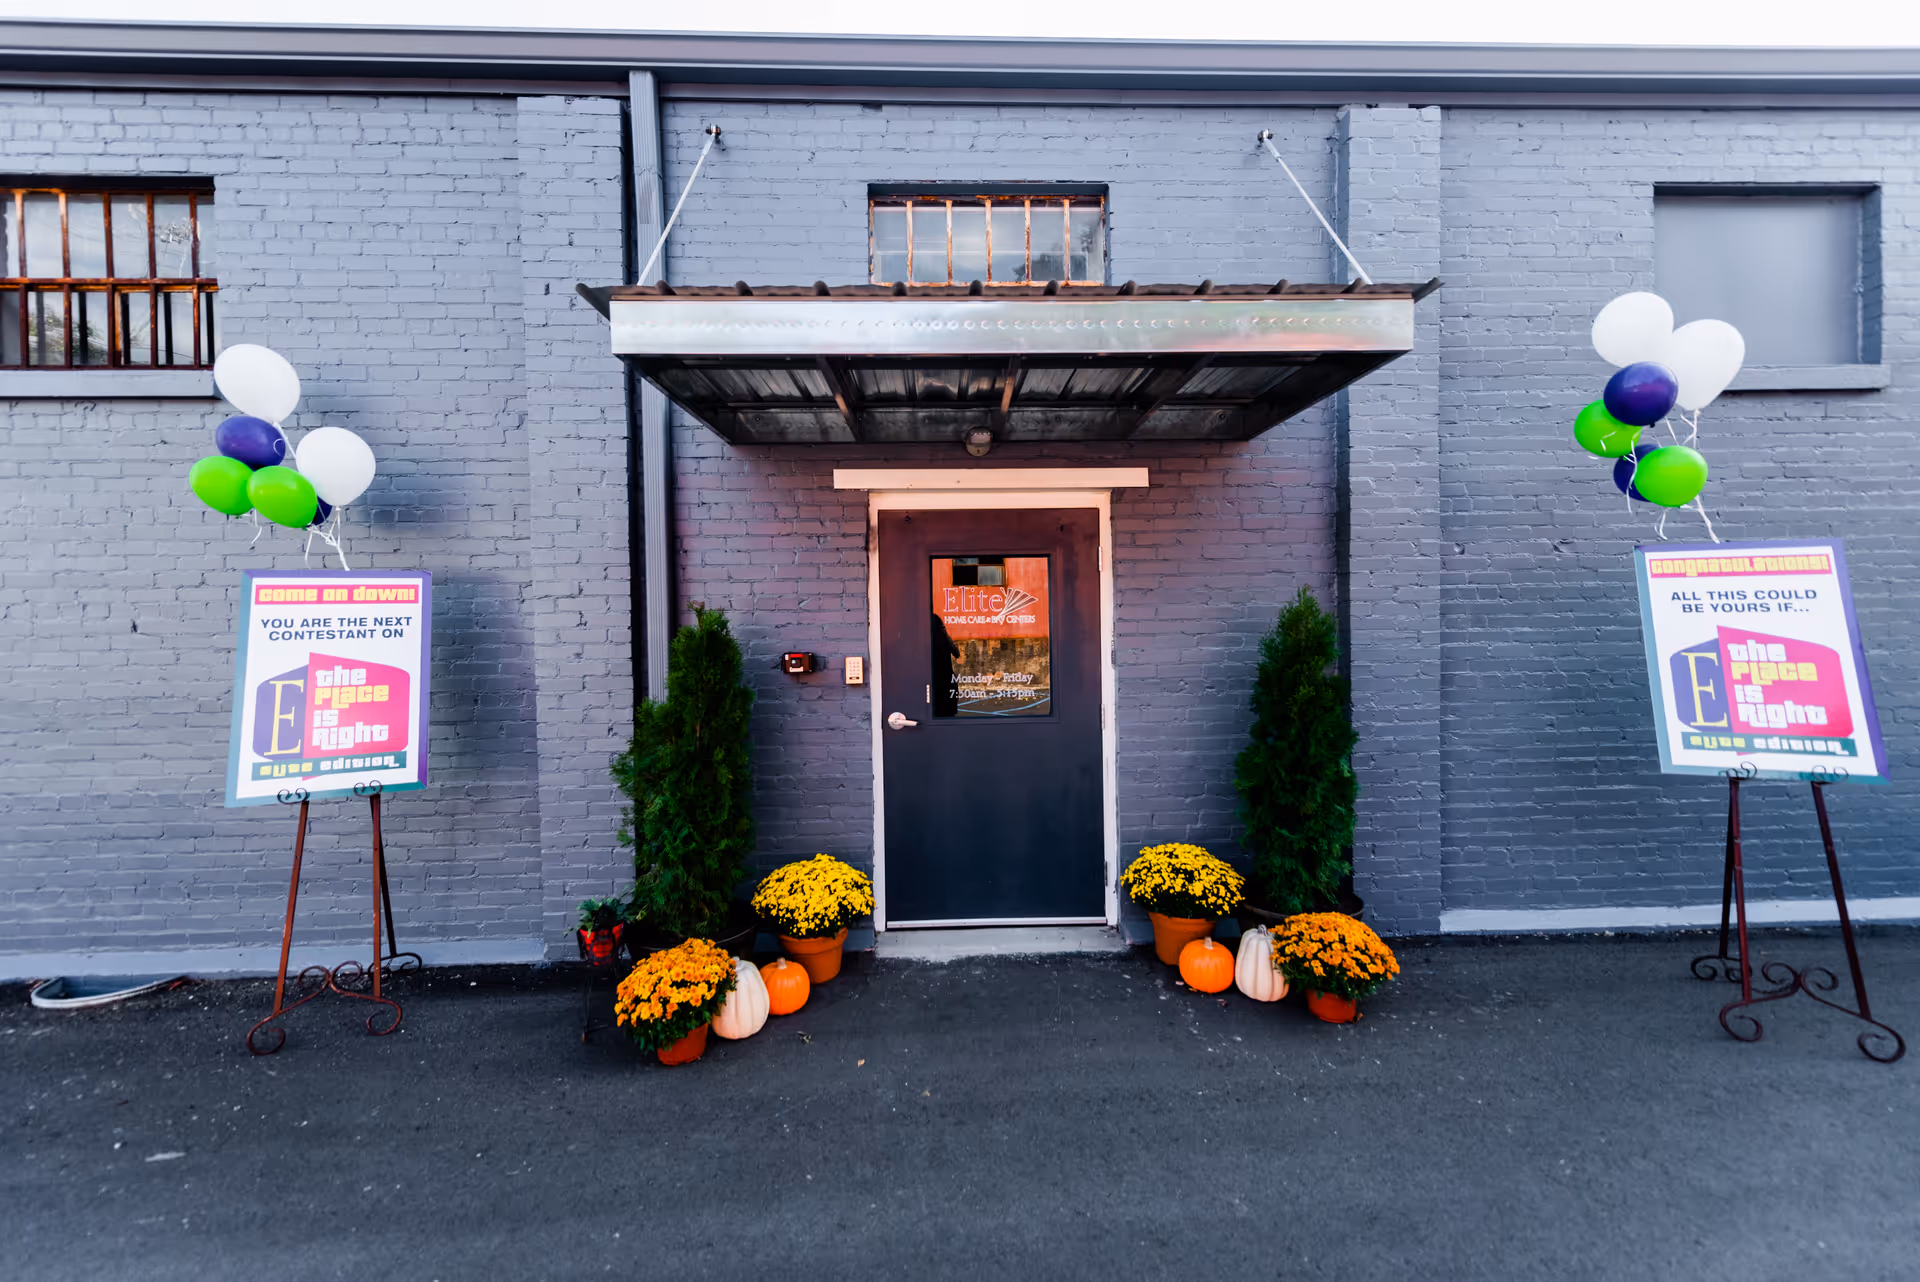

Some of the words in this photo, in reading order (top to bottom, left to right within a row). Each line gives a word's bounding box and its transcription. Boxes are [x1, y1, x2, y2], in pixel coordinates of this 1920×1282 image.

[323, 588, 348, 602] on
[353, 586, 415, 601] down!
[943, 586, 1003, 613] Elite
[1671, 591, 1701, 601] ALL
[1707, 590, 1747, 600] THIS
[1754, 589, 1817, 600] COULD
[1682, 603, 1705, 613] BE
[1711, 602, 1771, 613] YOURS
[1778, 602, 1810, 612] IF...
[261, 619, 294, 628] YOU
[300, 618, 332, 628] ARE
[338, 617, 368, 627] THE
[374, 616, 412, 626] NEXT
[944, 615, 967, 624] HOME
[967, 615, 985, 624] CARE
[1006, 615, 1036, 624] CENTERS
[269, 629, 377, 641] CONTESTANT
[382, 628, 404, 638] ON
[1727, 639, 1787, 662] the
[315, 665, 367, 687] the
[951, 672, 993, 685] Monday
[1003, 672, 1033, 684] Friday
[1680, 652, 1729, 728] E
[264, 679, 304, 756] E
